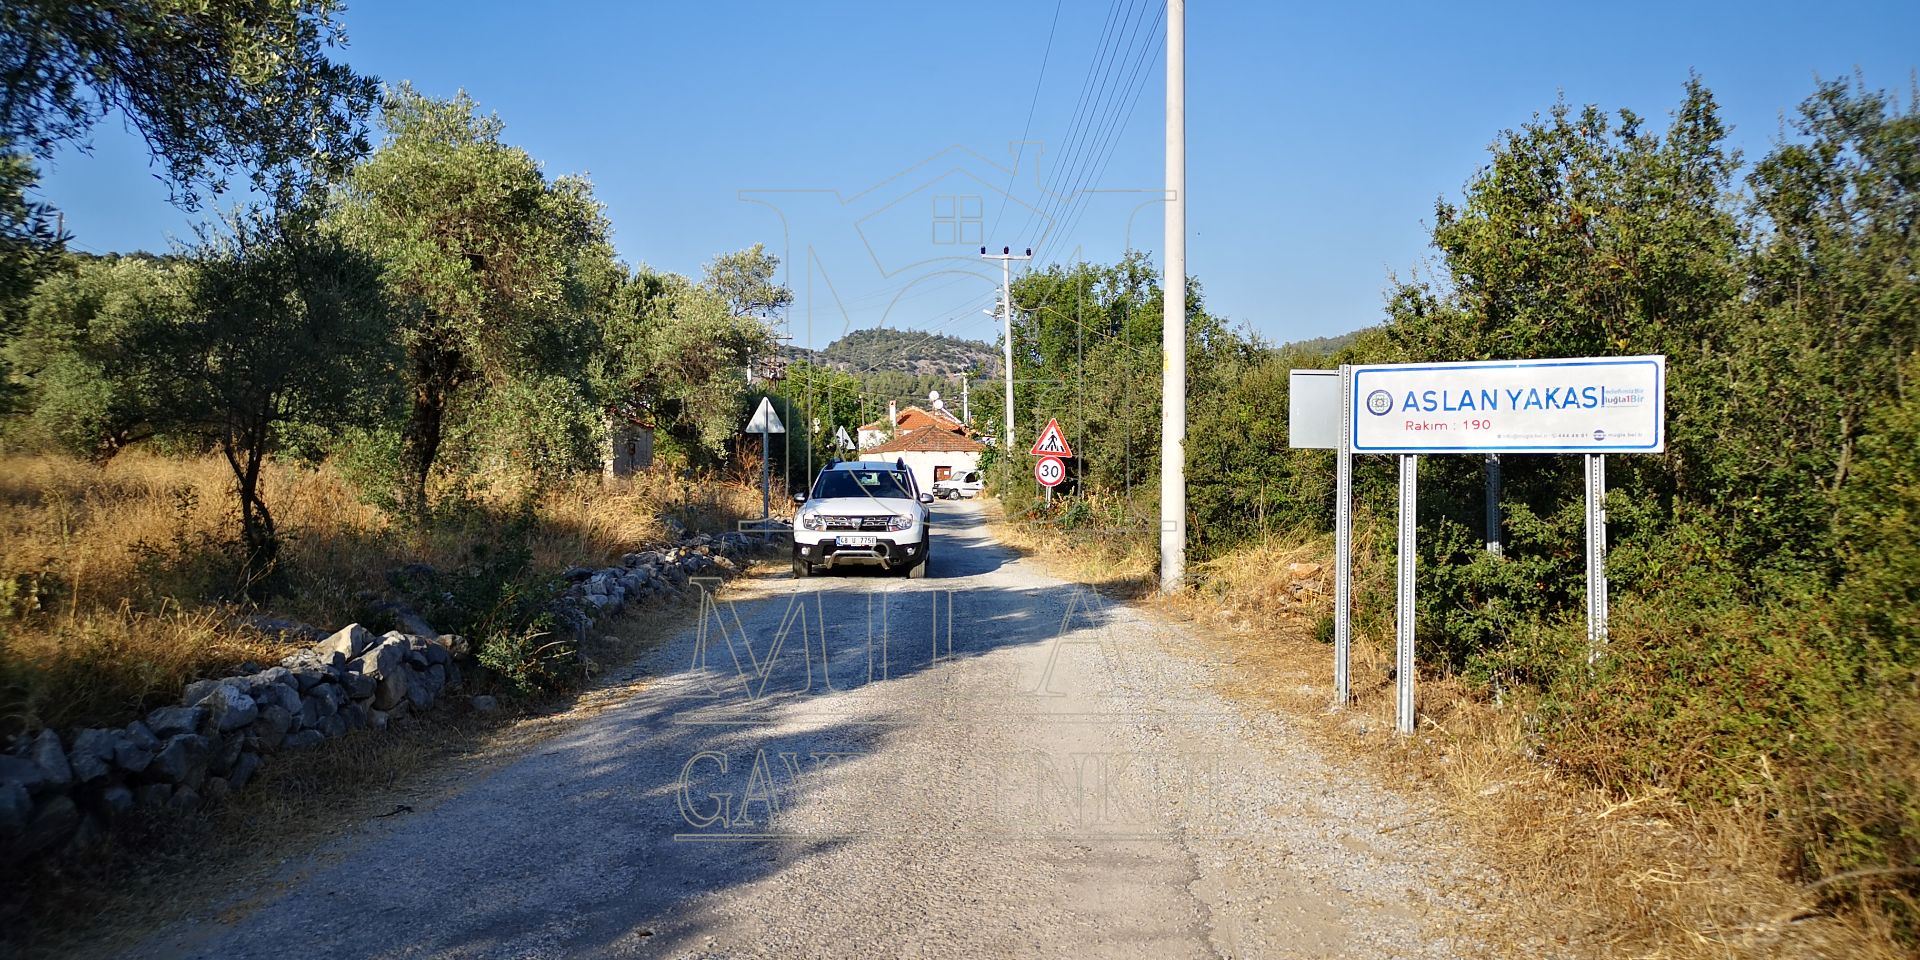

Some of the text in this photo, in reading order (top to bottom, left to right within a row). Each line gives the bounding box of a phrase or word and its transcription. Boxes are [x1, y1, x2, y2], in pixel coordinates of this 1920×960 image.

[1401, 385, 1605, 413] ASLAN YAKASI
[1405, 419, 1448, 431] Rakım
[1463, 419, 1491, 431] 190
[1041, 464, 1059, 478] 30
